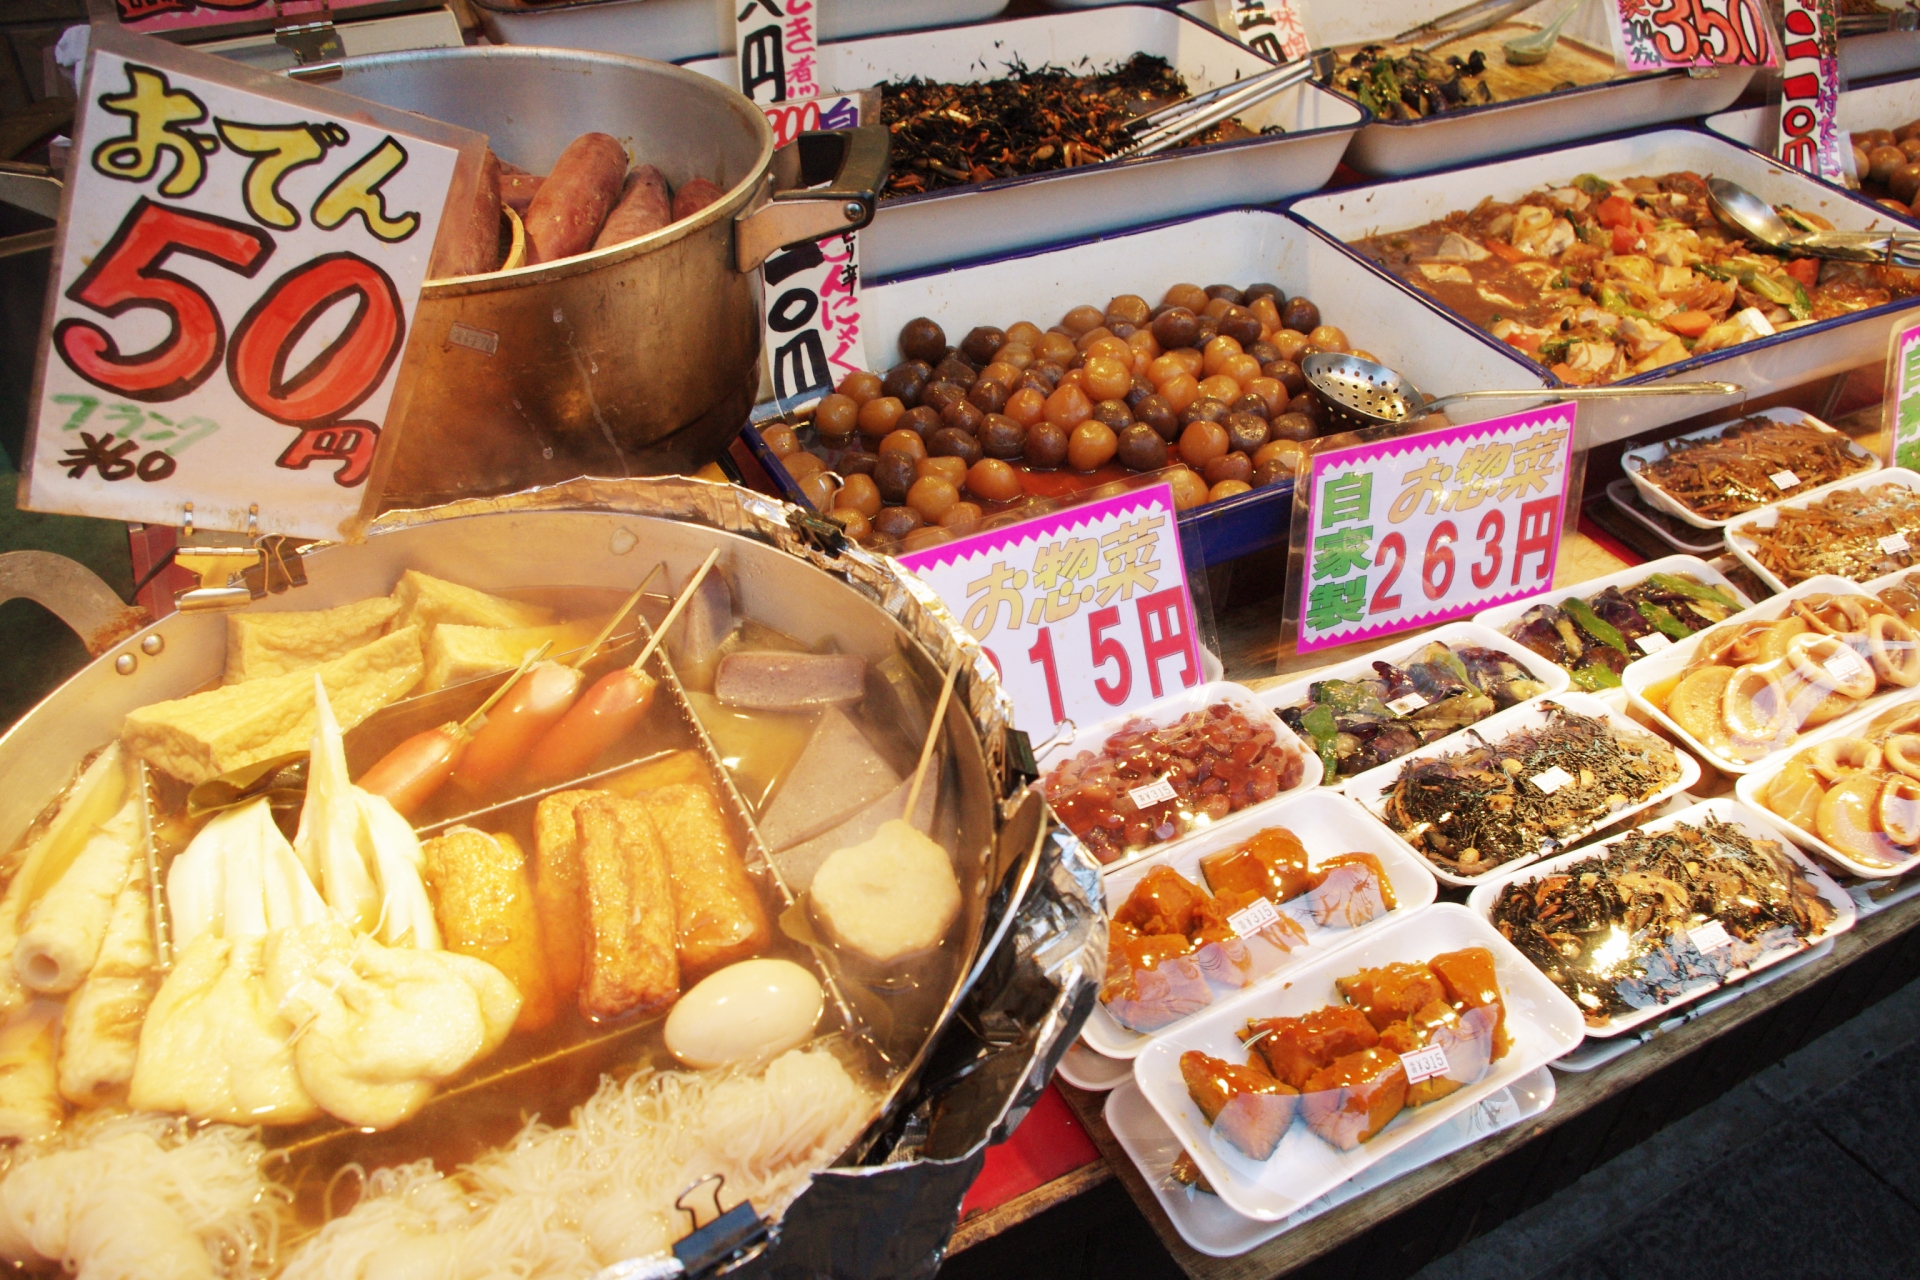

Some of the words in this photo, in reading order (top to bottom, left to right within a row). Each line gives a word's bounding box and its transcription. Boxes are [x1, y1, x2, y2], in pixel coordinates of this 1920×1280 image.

[1650, 0, 1769, 65] 350
[92, 63, 421, 243] おでん
[819, 232, 863, 393] こんにゃく
[52, 393, 222, 456] フランク
[1388, 428, 1568, 524] お惣菜
[961, 516, 1165, 642] お惣菜
[1306, 472, 1373, 632] 自家製
[1369, 494, 1560, 615] 263円
[980, 585, 1199, 725] 15円
